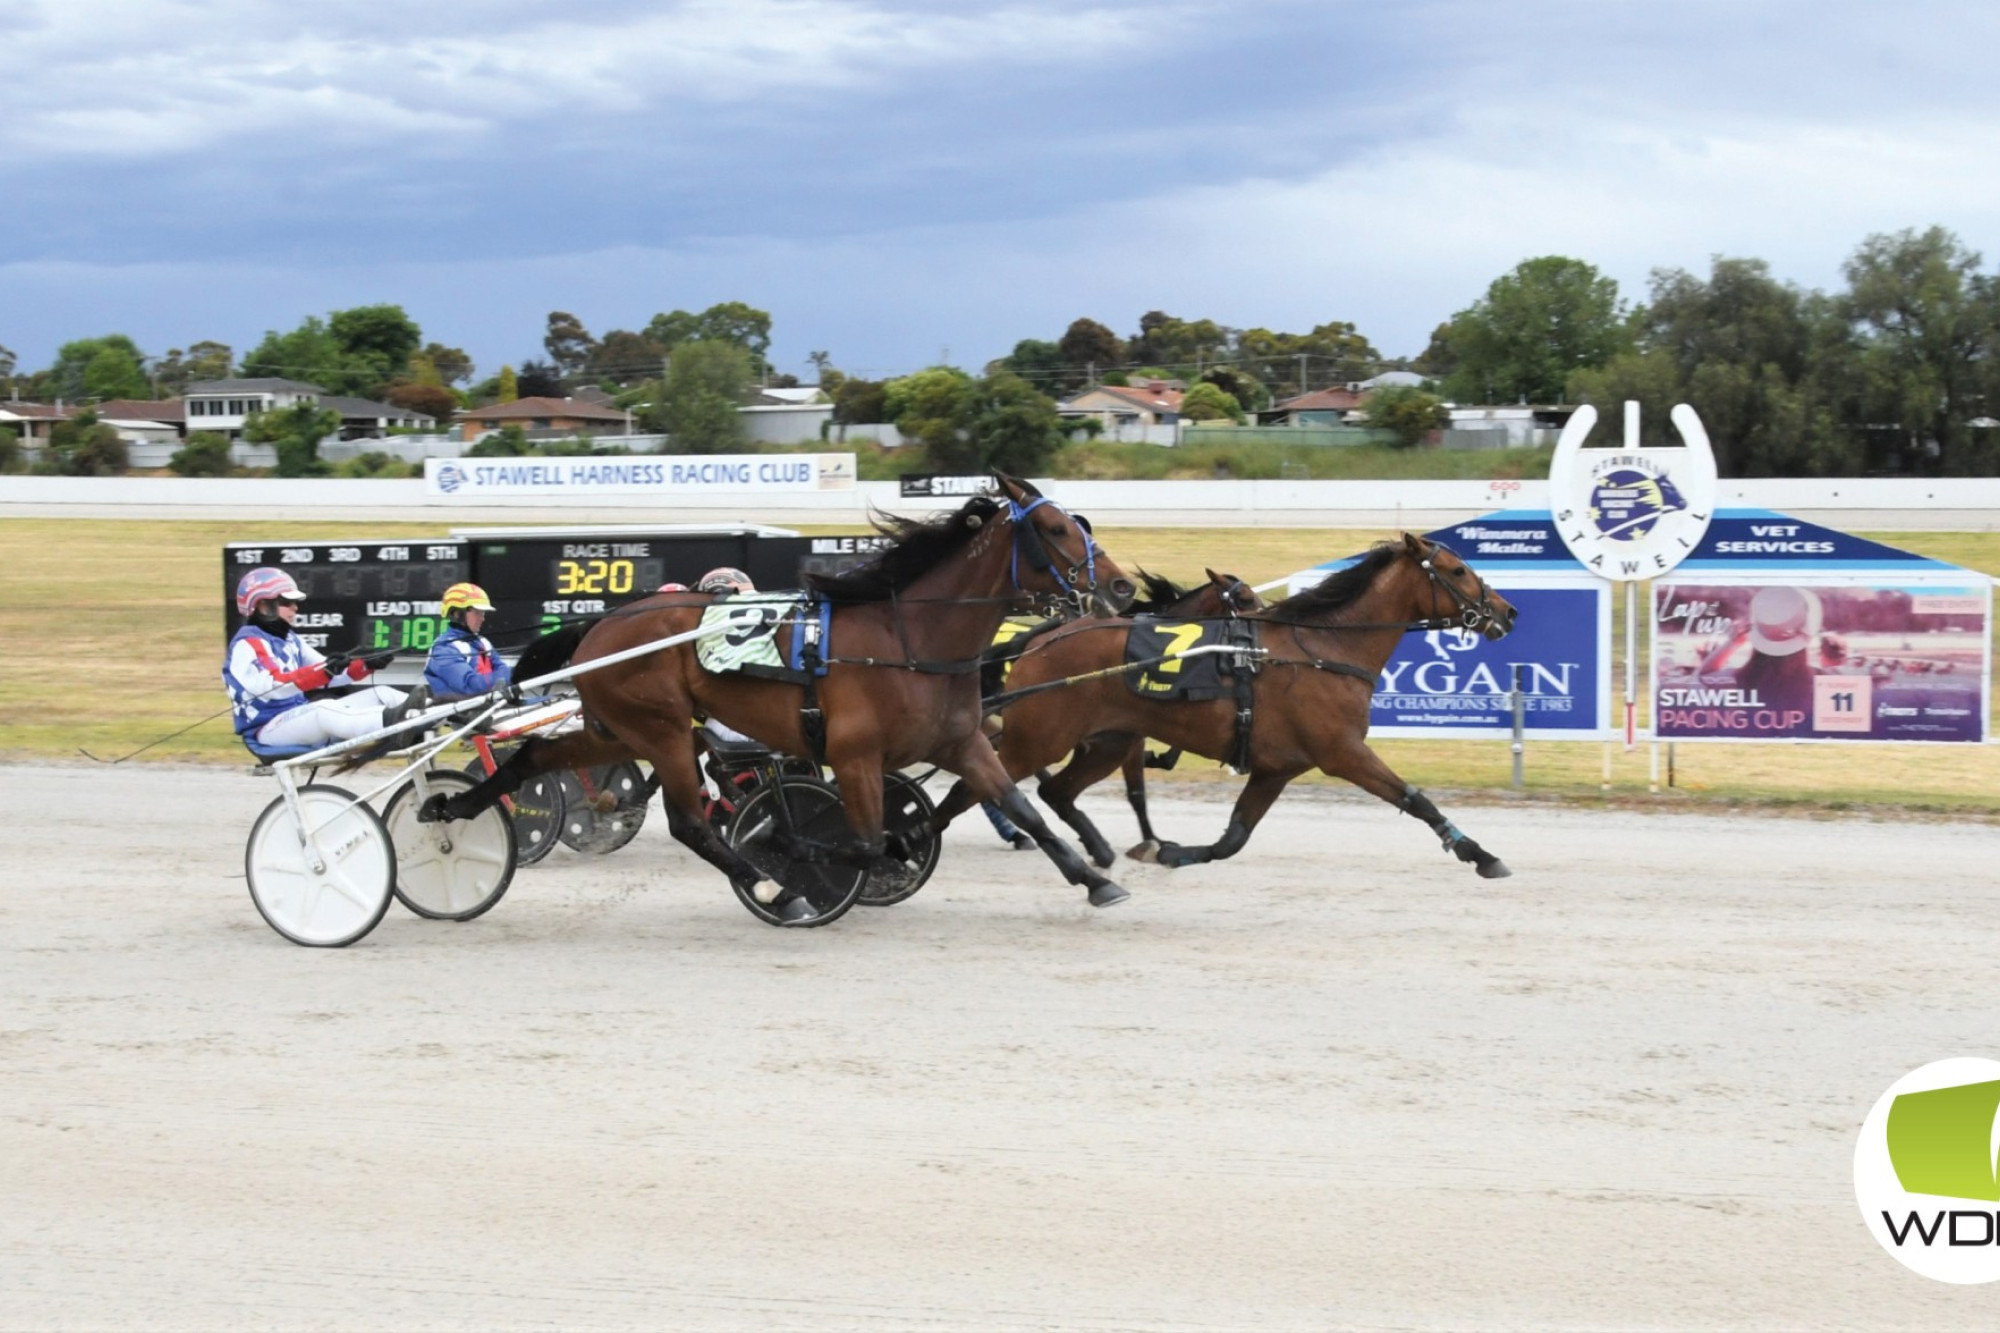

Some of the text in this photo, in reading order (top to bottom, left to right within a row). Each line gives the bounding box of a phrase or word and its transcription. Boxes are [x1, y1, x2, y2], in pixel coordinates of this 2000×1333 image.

[475, 462, 810, 486] STAWELL HARNESS RACING CLUB
[1490, 481, 1521, 491] 600
[1455, 525, 1549, 541] Wimmera
[1749, 524, 1801, 537] VET
[563, 543, 650, 558] RACE TIME
[811, 538, 855, 554] MILE
[1477, 541, 1544, 555] Mallee
[1715, 540, 1835, 554] SERVICES
[235, 546, 458, 564] 1ST 2ND 3RD 4TH 5TH
[557, 560, 634, 594] 3:20
[366, 601, 442, 616] LEAD TIM
[542, 600, 606, 614] 1ST QTR
[293, 613, 344, 628] CLEAR
[1154, 623, 1204, 673] 7
[1380, 661, 1571, 695] YGAIN
[1394, 698, 1488, 711] CHAMPIONS
[1659, 688, 1765, 707] STAWELL
[1830, 692, 1854, 712] 11
[1659, 709, 1805, 729] PACING CUP
